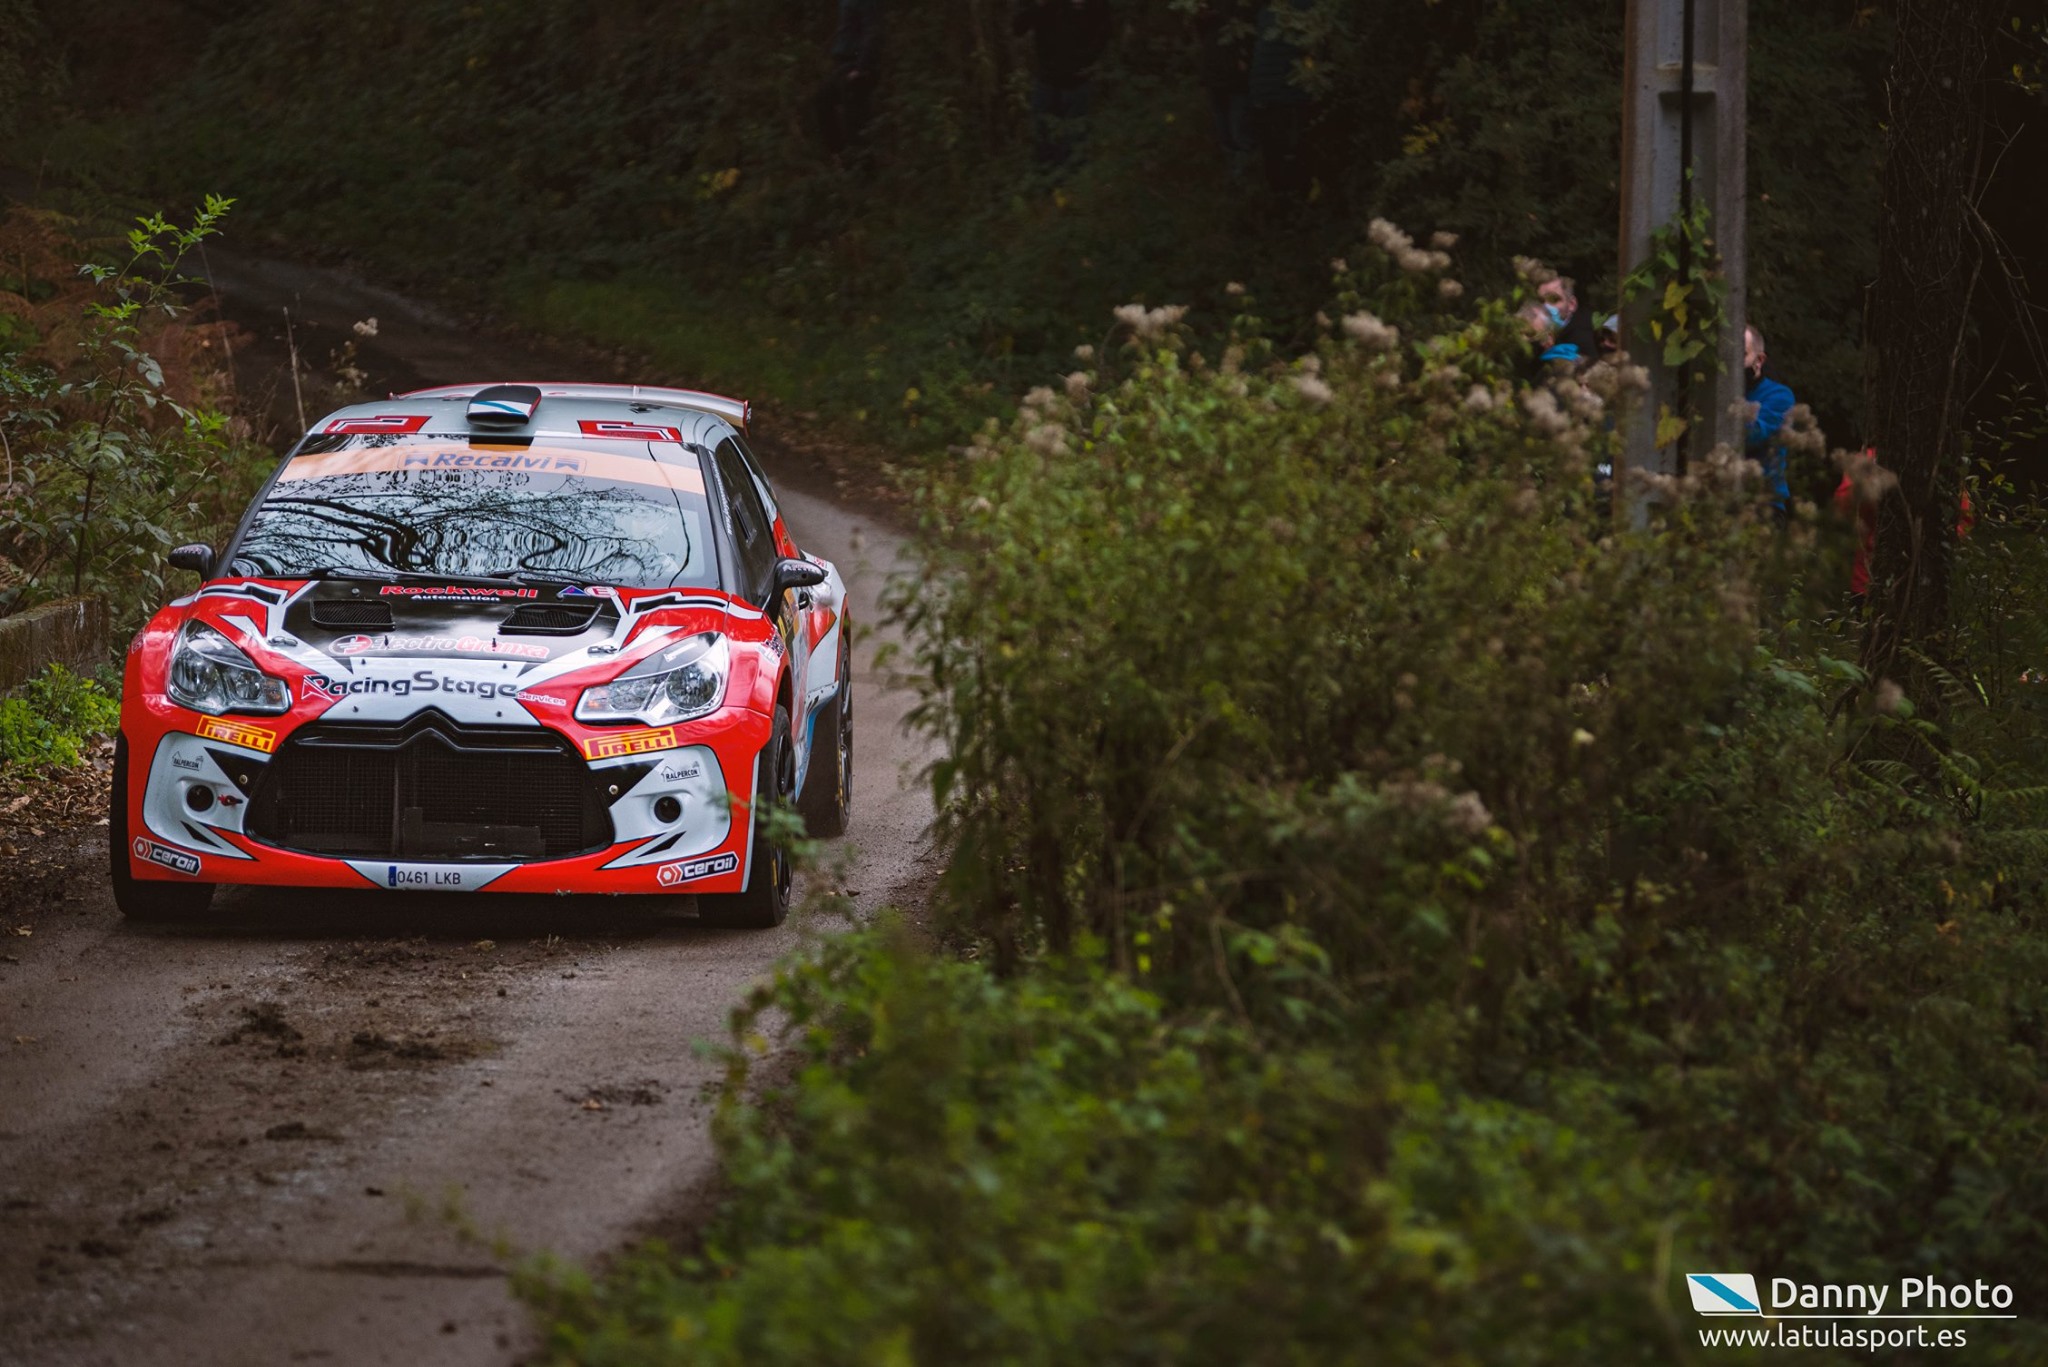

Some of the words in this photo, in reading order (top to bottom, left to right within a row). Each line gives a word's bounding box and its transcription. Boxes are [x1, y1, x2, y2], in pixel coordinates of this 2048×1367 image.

[434, 453, 552, 469] Recalvi
[379, 585, 538, 598] Rockwell
[411, 594, 500, 602] Automation
[198, 717, 275, 751] PIRELLI
[586, 729, 675, 758] PIRELLI
[665, 769, 698, 780] RALPERCON
[152, 849, 197, 871] ceroil
[684, 859, 733, 877] ceroil
[397, 871, 428, 884] 0461
[435, 872, 461, 885] LKB
